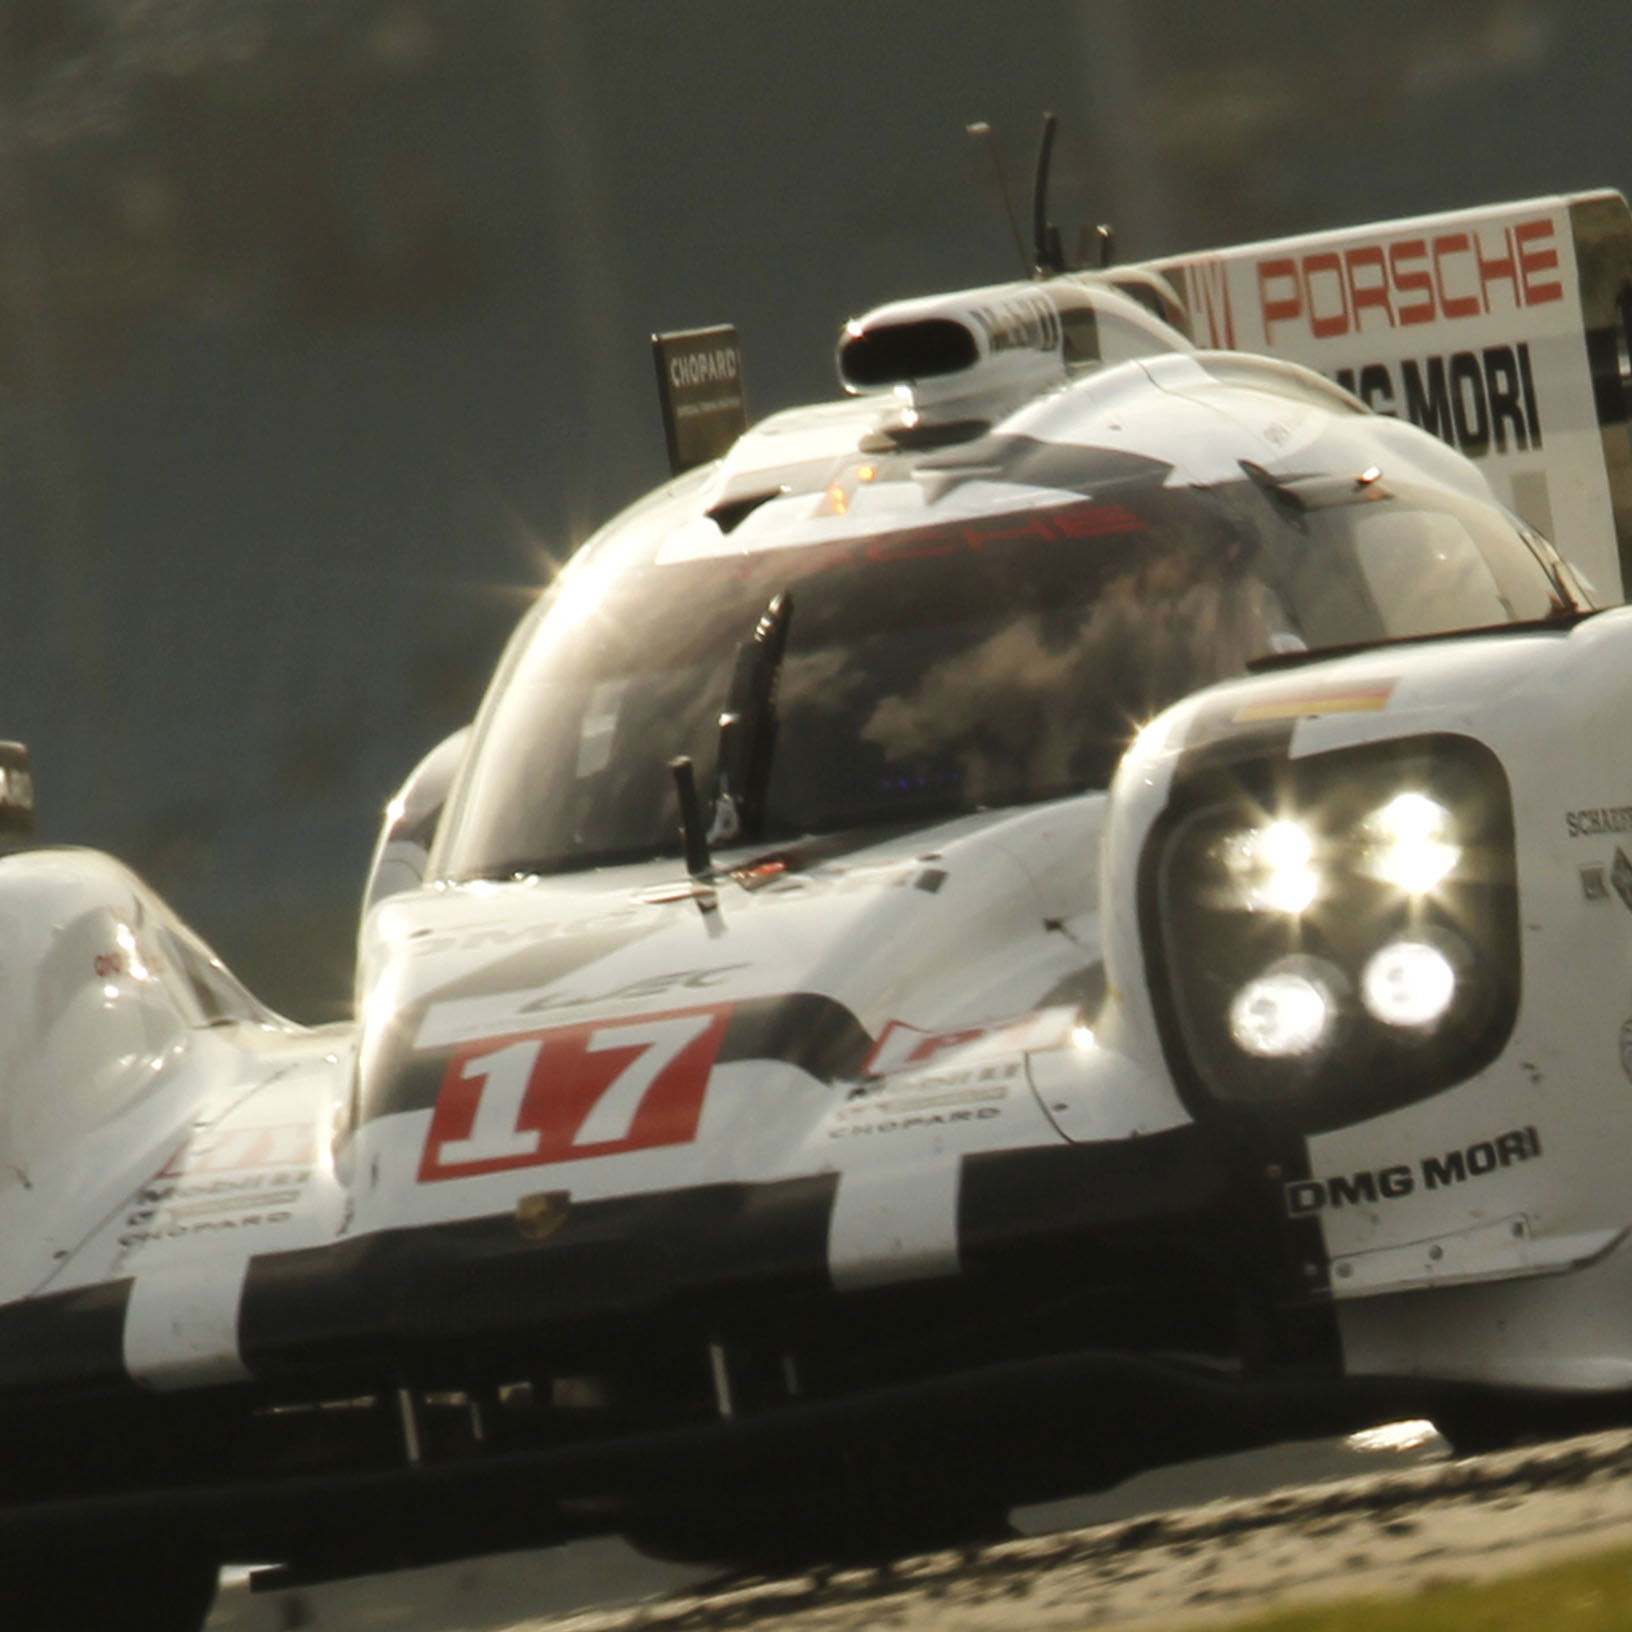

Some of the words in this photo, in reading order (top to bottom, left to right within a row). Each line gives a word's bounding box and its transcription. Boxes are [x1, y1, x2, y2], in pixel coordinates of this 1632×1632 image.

[1256, 218, 1563, 346] PORSCHE
[671, 348, 737, 387] CHOPARD
[1401, 342, 1543, 458] MORI
[438, 1013, 715, 1166] 17
[828, 1107, 1001, 1139] CHOPARD
[1287, 1165, 1415, 1215] DMG
[1420, 1125, 1543, 1190] MORI
